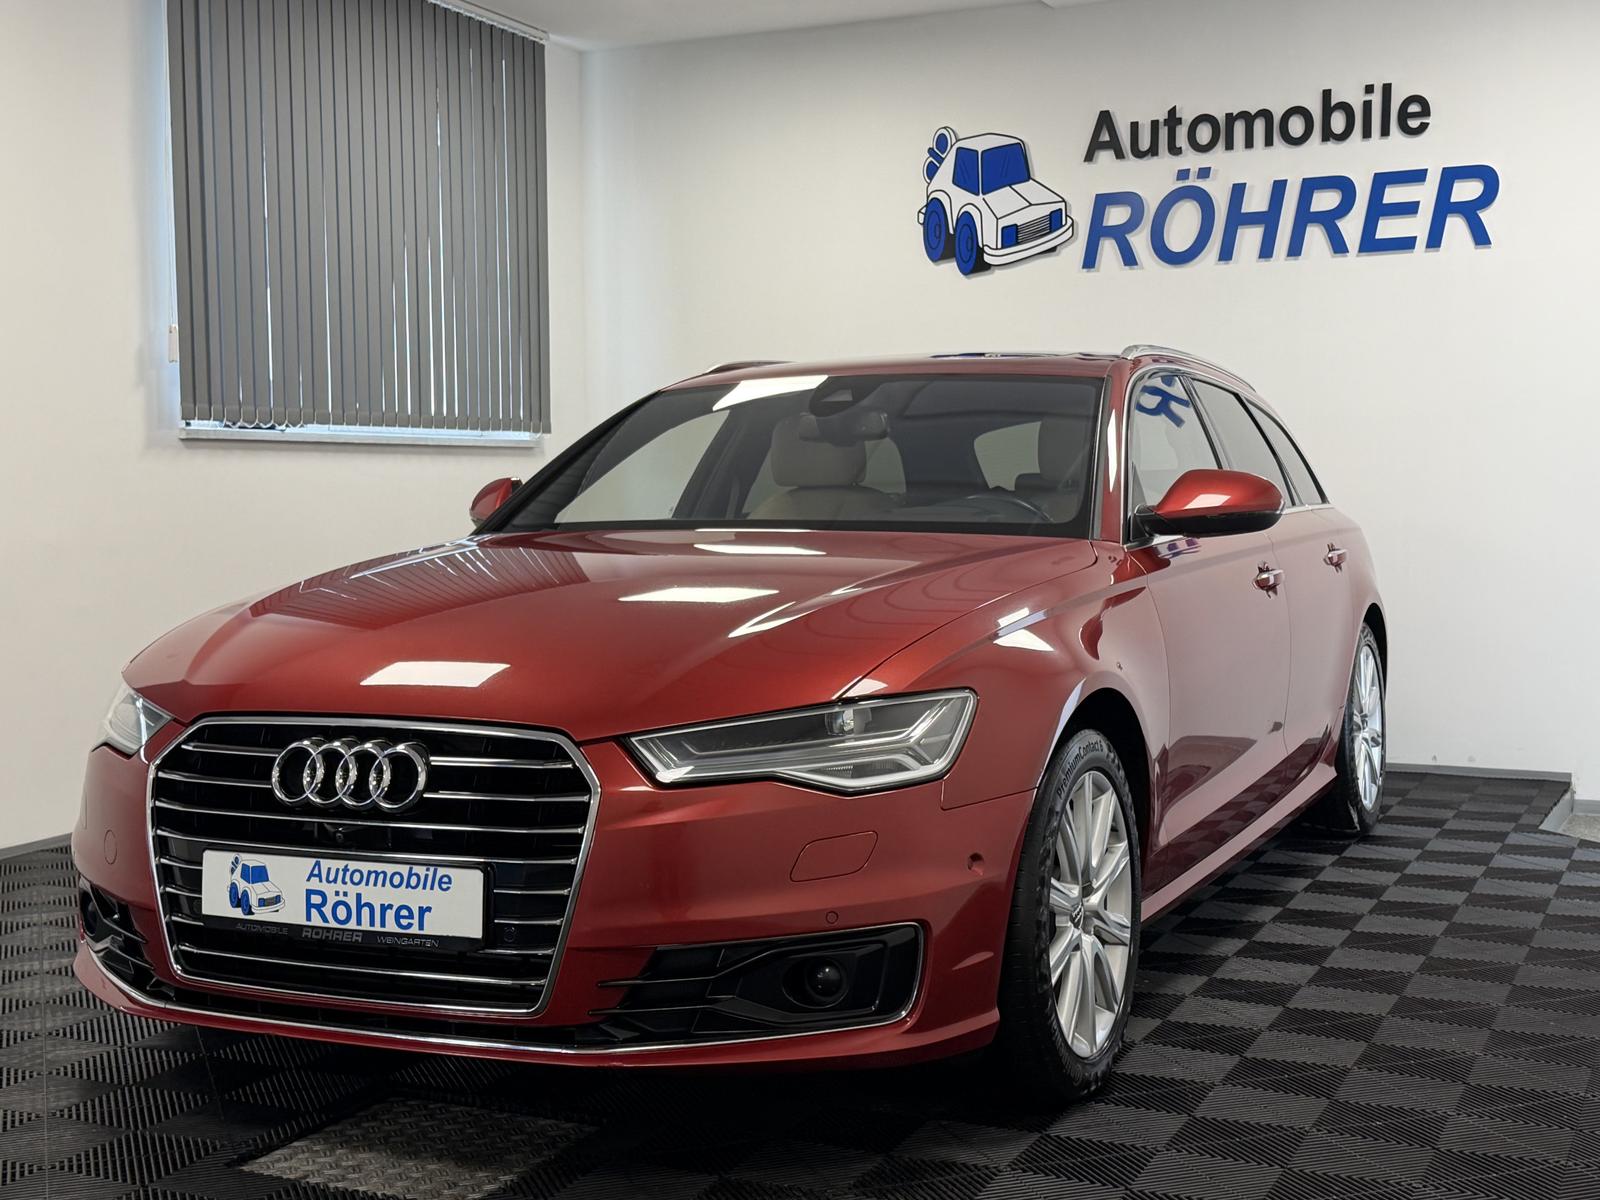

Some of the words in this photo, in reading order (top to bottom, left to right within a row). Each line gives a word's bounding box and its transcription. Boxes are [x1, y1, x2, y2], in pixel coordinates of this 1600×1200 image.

[1083, 82, 1431, 163] Automobile
[1081, 164, 1500, 270] RÖHRER
[306, 859, 453, 892] Automobile
[305, 888, 433, 931] Röhrer
[376, 935, 440, 948] WEINGARTEN
